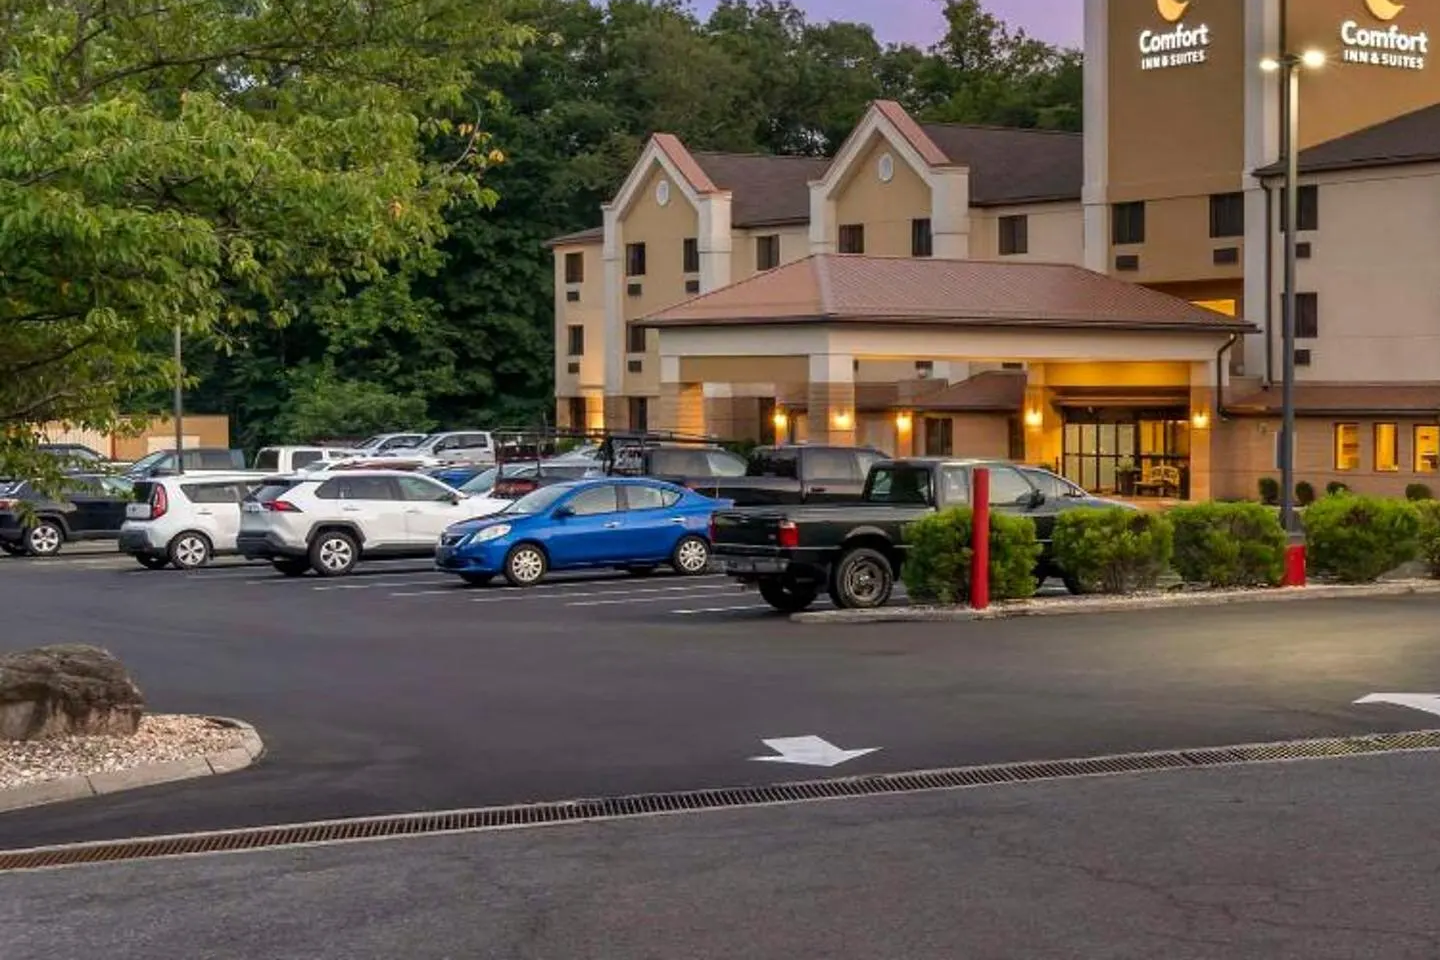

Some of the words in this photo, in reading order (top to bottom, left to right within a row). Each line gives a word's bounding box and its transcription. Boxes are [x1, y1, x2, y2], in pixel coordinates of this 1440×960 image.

[1140, 23, 1208, 53] Comfort
[1341, 20, 1428, 52] Comfort
[1141, 56, 1161, 70] INN
[1170, 49, 1205, 66] SUITES
[1344, 49, 1368, 63] INN
[1370, 51, 1380, 64] &
[1381, 52, 1424, 69] SUITES
